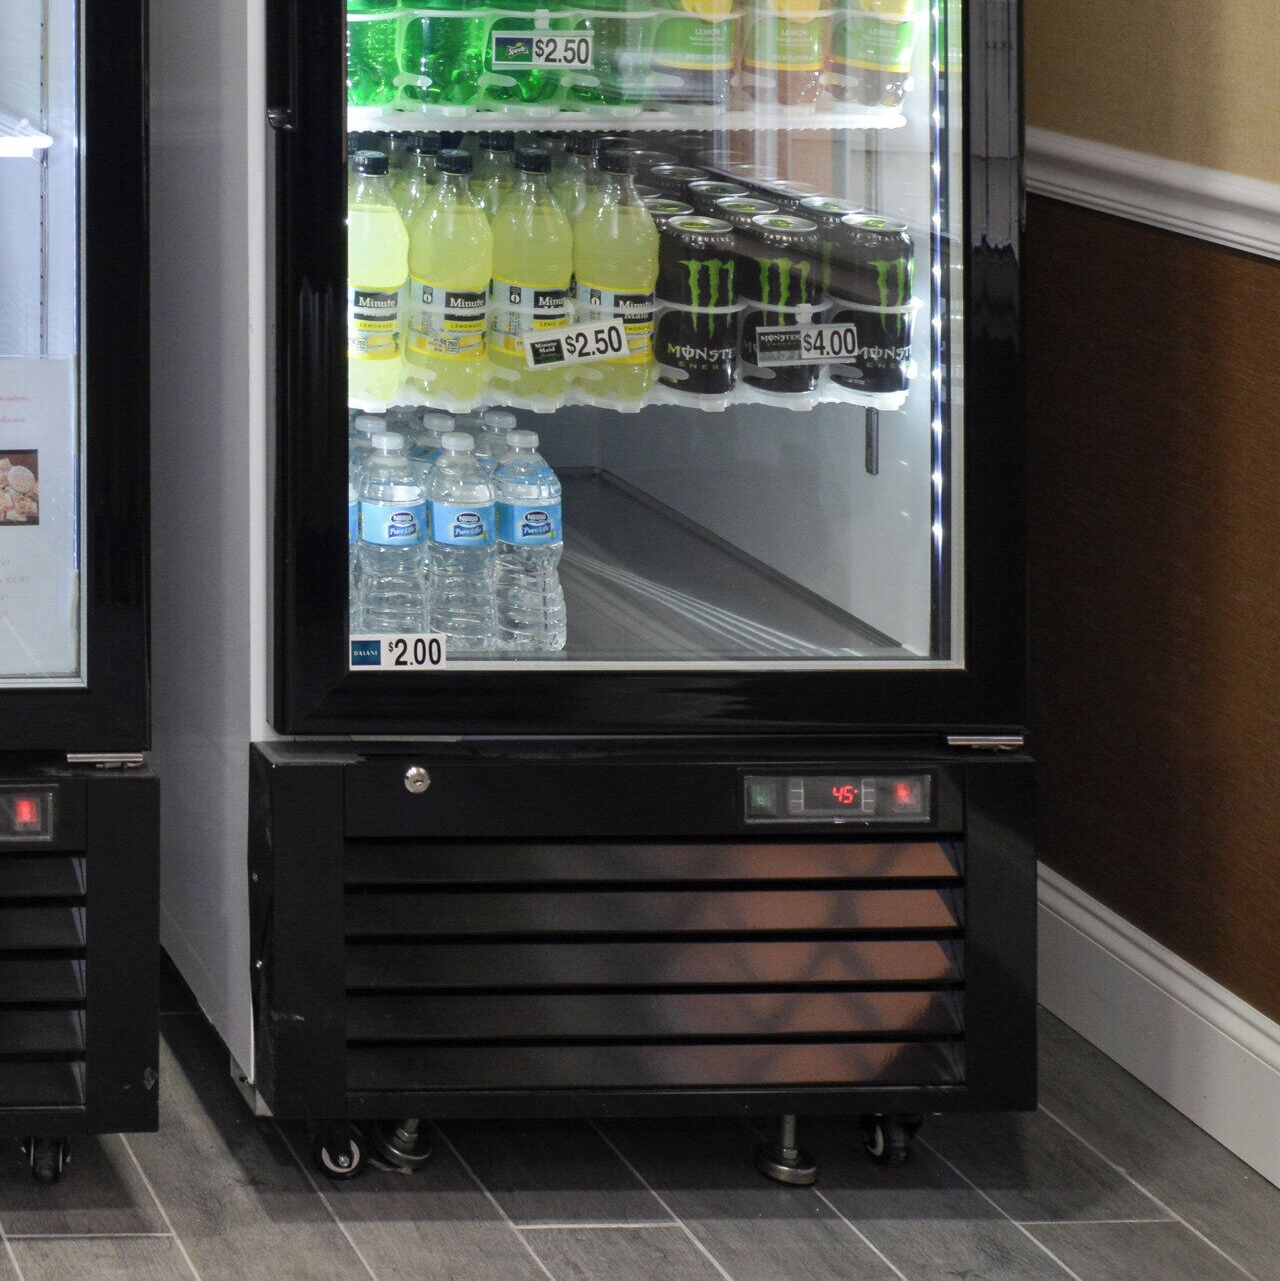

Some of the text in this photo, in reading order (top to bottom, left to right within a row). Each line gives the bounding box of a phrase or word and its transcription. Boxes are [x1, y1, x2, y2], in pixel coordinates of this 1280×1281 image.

[507, 38, 590, 64] Sprite $2.50
[359, 296, 395, 308] Minute
[450, 297, 484, 308] Minute
[620, 298, 652, 311] Minute
[534, 326, 622, 358] Minute $2.50
[803, 328, 857, 356] $4.00
[539, 346, 555, 354] Maid
[389, 528, 403, 537] Pure
[455, 528, 468, 537] Pure
[523, 527, 537, 536] Pure
[388, 638, 442, 667] $2.00
